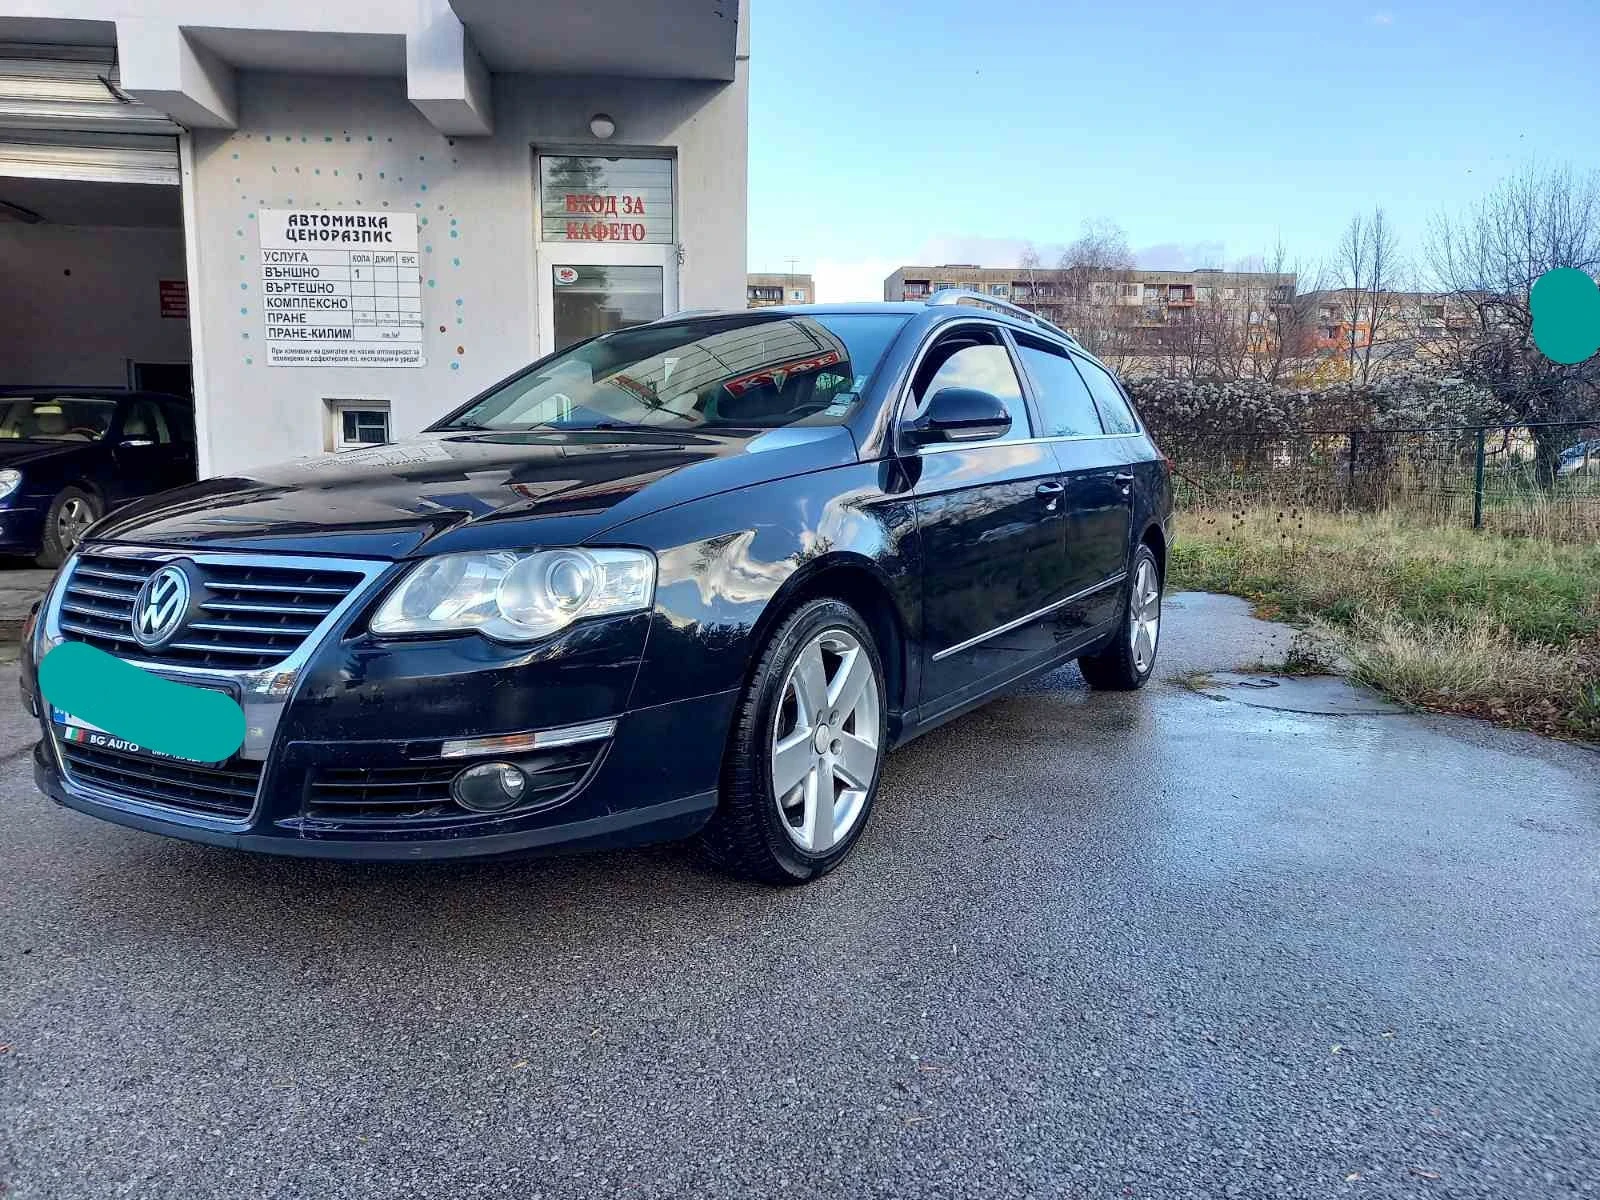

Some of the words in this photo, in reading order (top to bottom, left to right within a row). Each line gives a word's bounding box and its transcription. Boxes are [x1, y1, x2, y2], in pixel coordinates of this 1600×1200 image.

[565, 194, 618, 218] ВХОД
[622, 195, 645, 214] ЗА
[288, 214, 388, 229] АВТОМИВКА
[286, 229, 392, 243] ЦЕНОРАЗПИС
[566, 221, 646, 241] КАФЕТО
[263, 251, 309, 263] УСЛУГА
[352, 254, 370, 263] КОЛА
[374, 255, 395, 264] ДЖИП
[265, 267, 320, 278] ВЪНШНО
[355, 268, 360, 279] 1
[266, 282, 335, 294] ВЪРТЕШНО
[266, 297, 348, 309] КОМПЛЕКСНО
[267, 312, 307, 324] ПРАНЕ
[268, 327, 352, 339] ПРАНЕ-КИЛИМ
[89, 734, 105, 746] BG
[107, 738, 139, 752] AUTO
